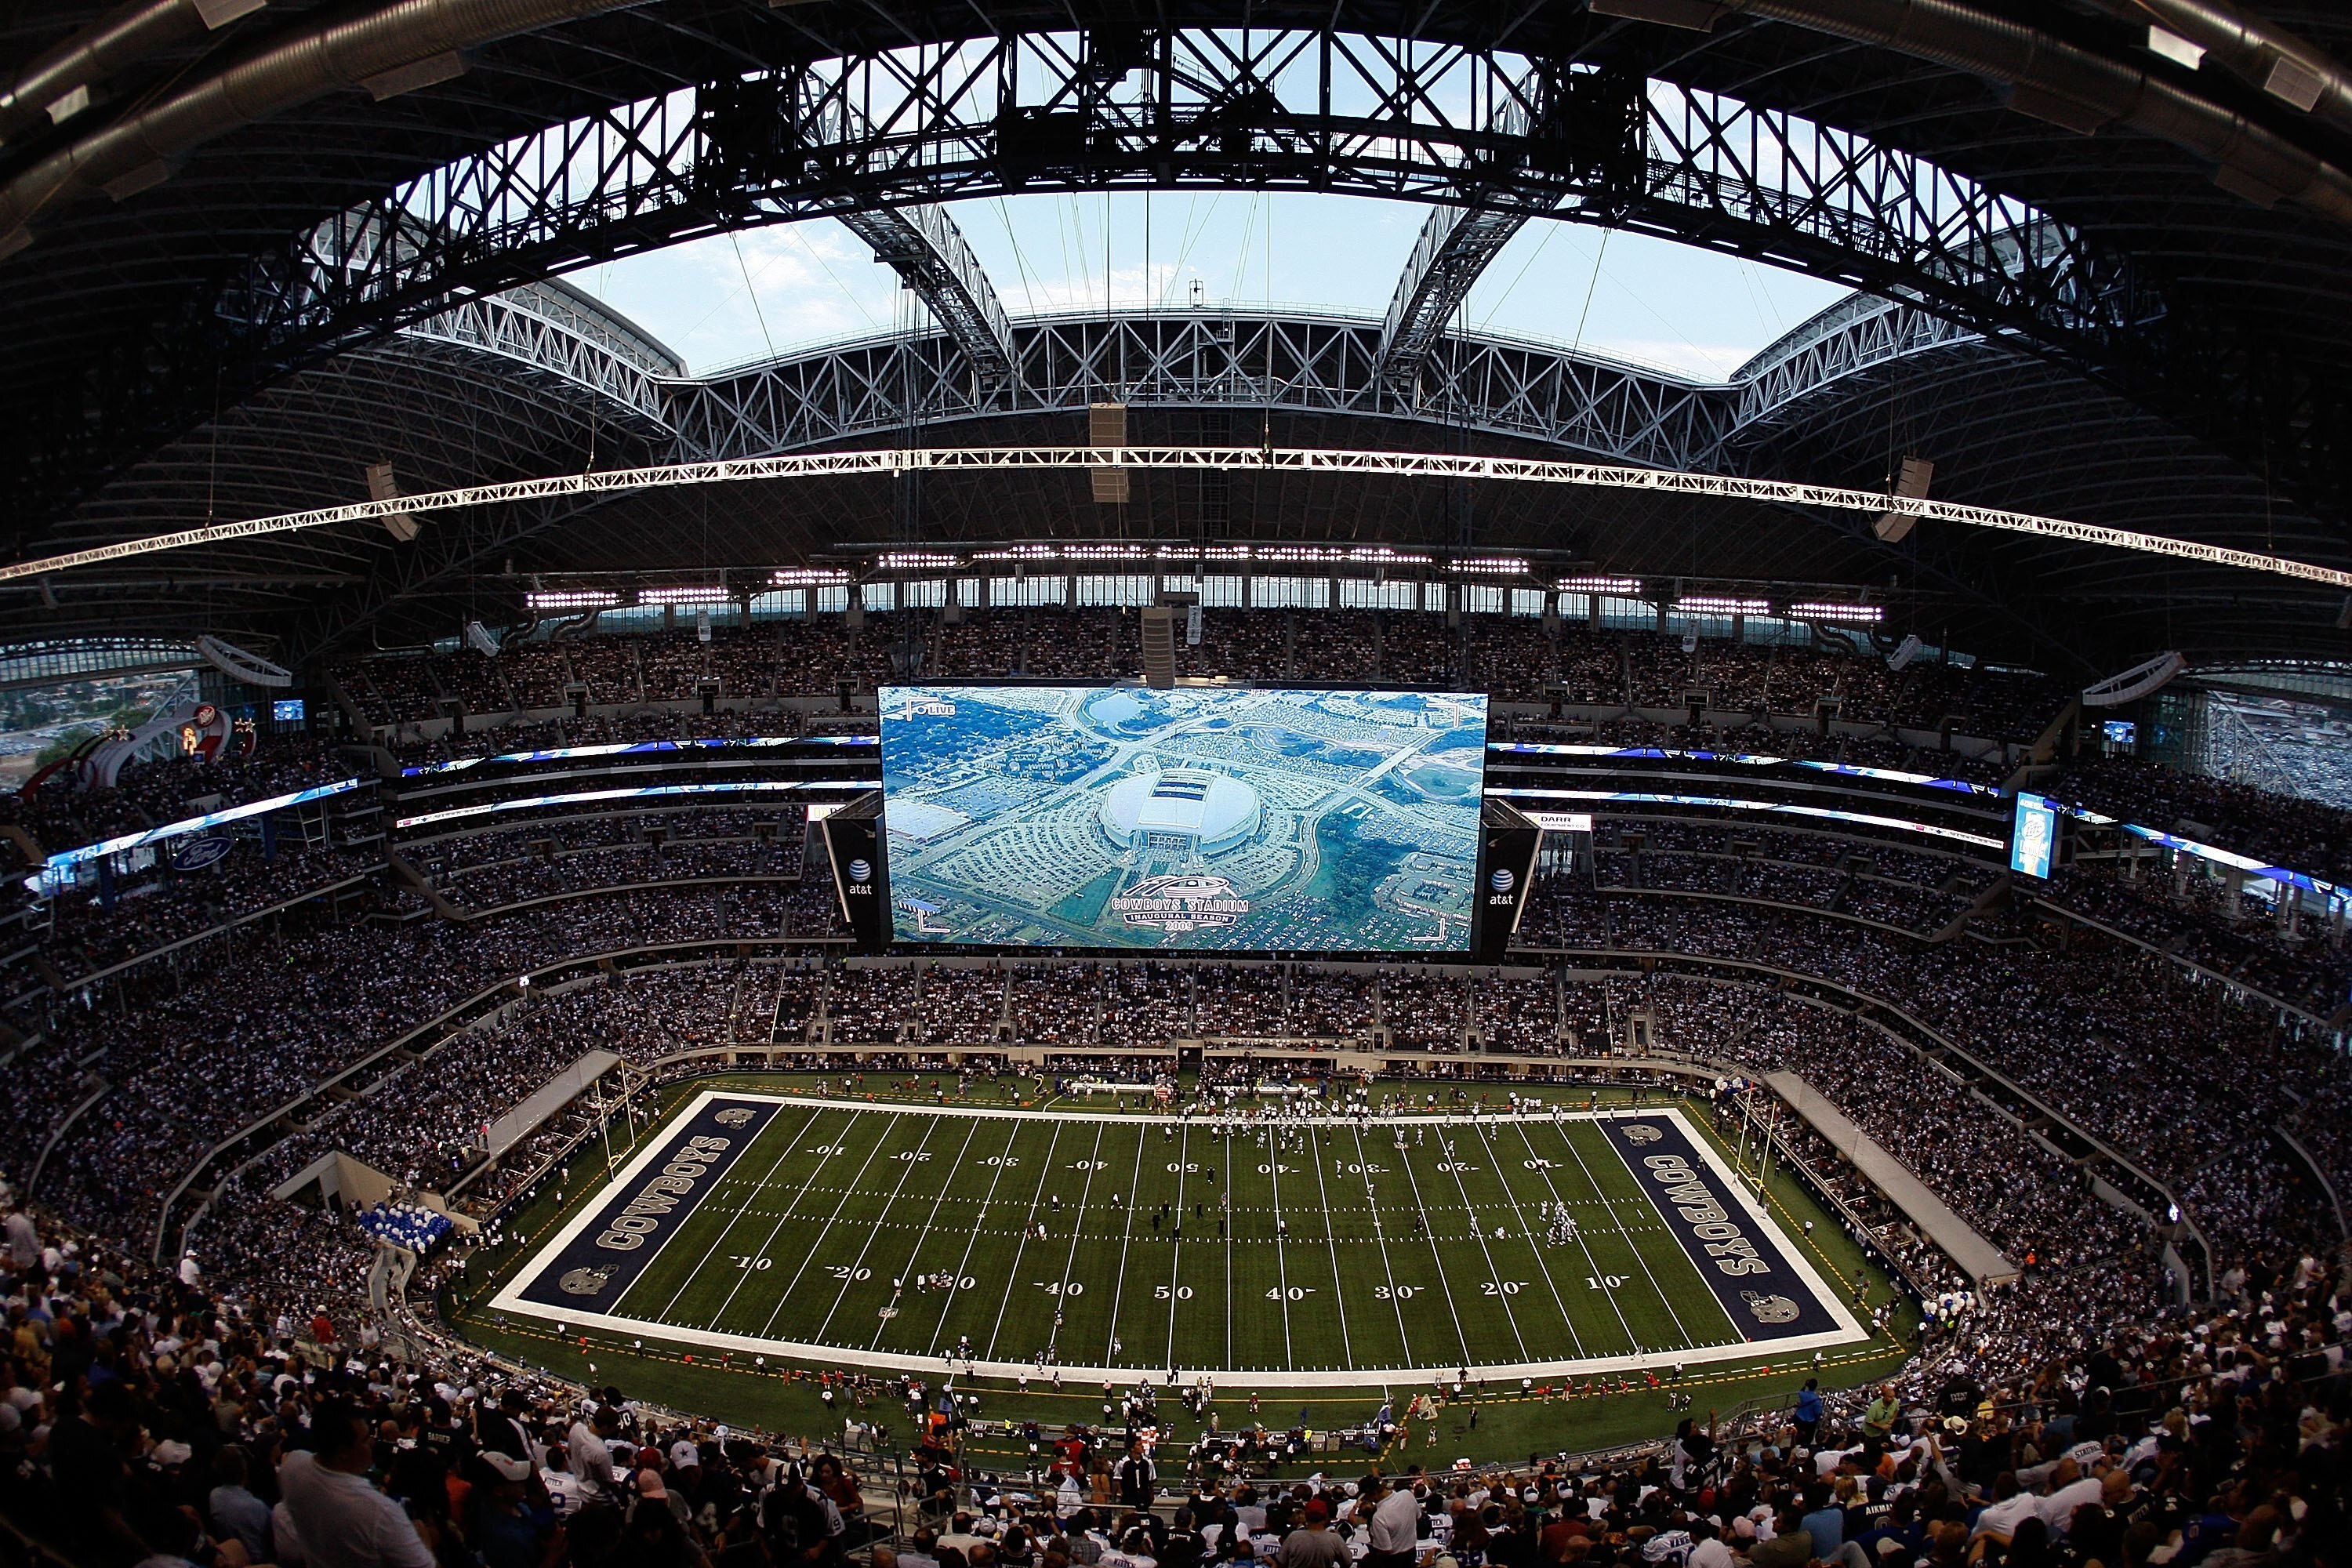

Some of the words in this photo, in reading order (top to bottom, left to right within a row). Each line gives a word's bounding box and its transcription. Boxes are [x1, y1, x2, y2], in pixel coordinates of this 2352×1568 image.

[183, 842, 222, 866] Ford
[849, 884, 872, 895] at&t
[1111, 898, 1181, 911] COWBOYS
[1186, 899, 1249, 913] STADIUM
[1490, 894, 1514, 905] at&t
[1131, 913, 1186, 921] INAUGURAL
[1190, 913, 1229, 923] SEASON
[1165, 921, 1193, 931] 2009
[816, 1145, 847, 1156] 10
[899, 1151, 932, 1162] 20
[987, 1156, 1020, 1167] 30
[1076, 1160, 1108, 1171] 40
[1436, 1162, 1469, 1173] 20
[1166, 1163, 1199, 1173] 50
[1258, 1163, 1290, 1174] 40
[1348, 1163, 1380, 1174] 30
[596, 1135, 730, 1250] COWBOYS
[1643, 1155, 1771, 1276] COWBOYS
[735, 1256, 772, 1271] 10
[833, 1265, 872, 1281] 20
[1480, 1280, 1519, 1295] 20
[1584, 1275, 1622, 1290] 10
[1044, 1282, 1083, 1296] 40
[1154, 1286, 1193, 1300] 50
[1265, 1286, 1304, 1301] 40
[1374, 1285, 1413, 1300] 30
[1865, 1503, 1893, 1515] AIKMA
